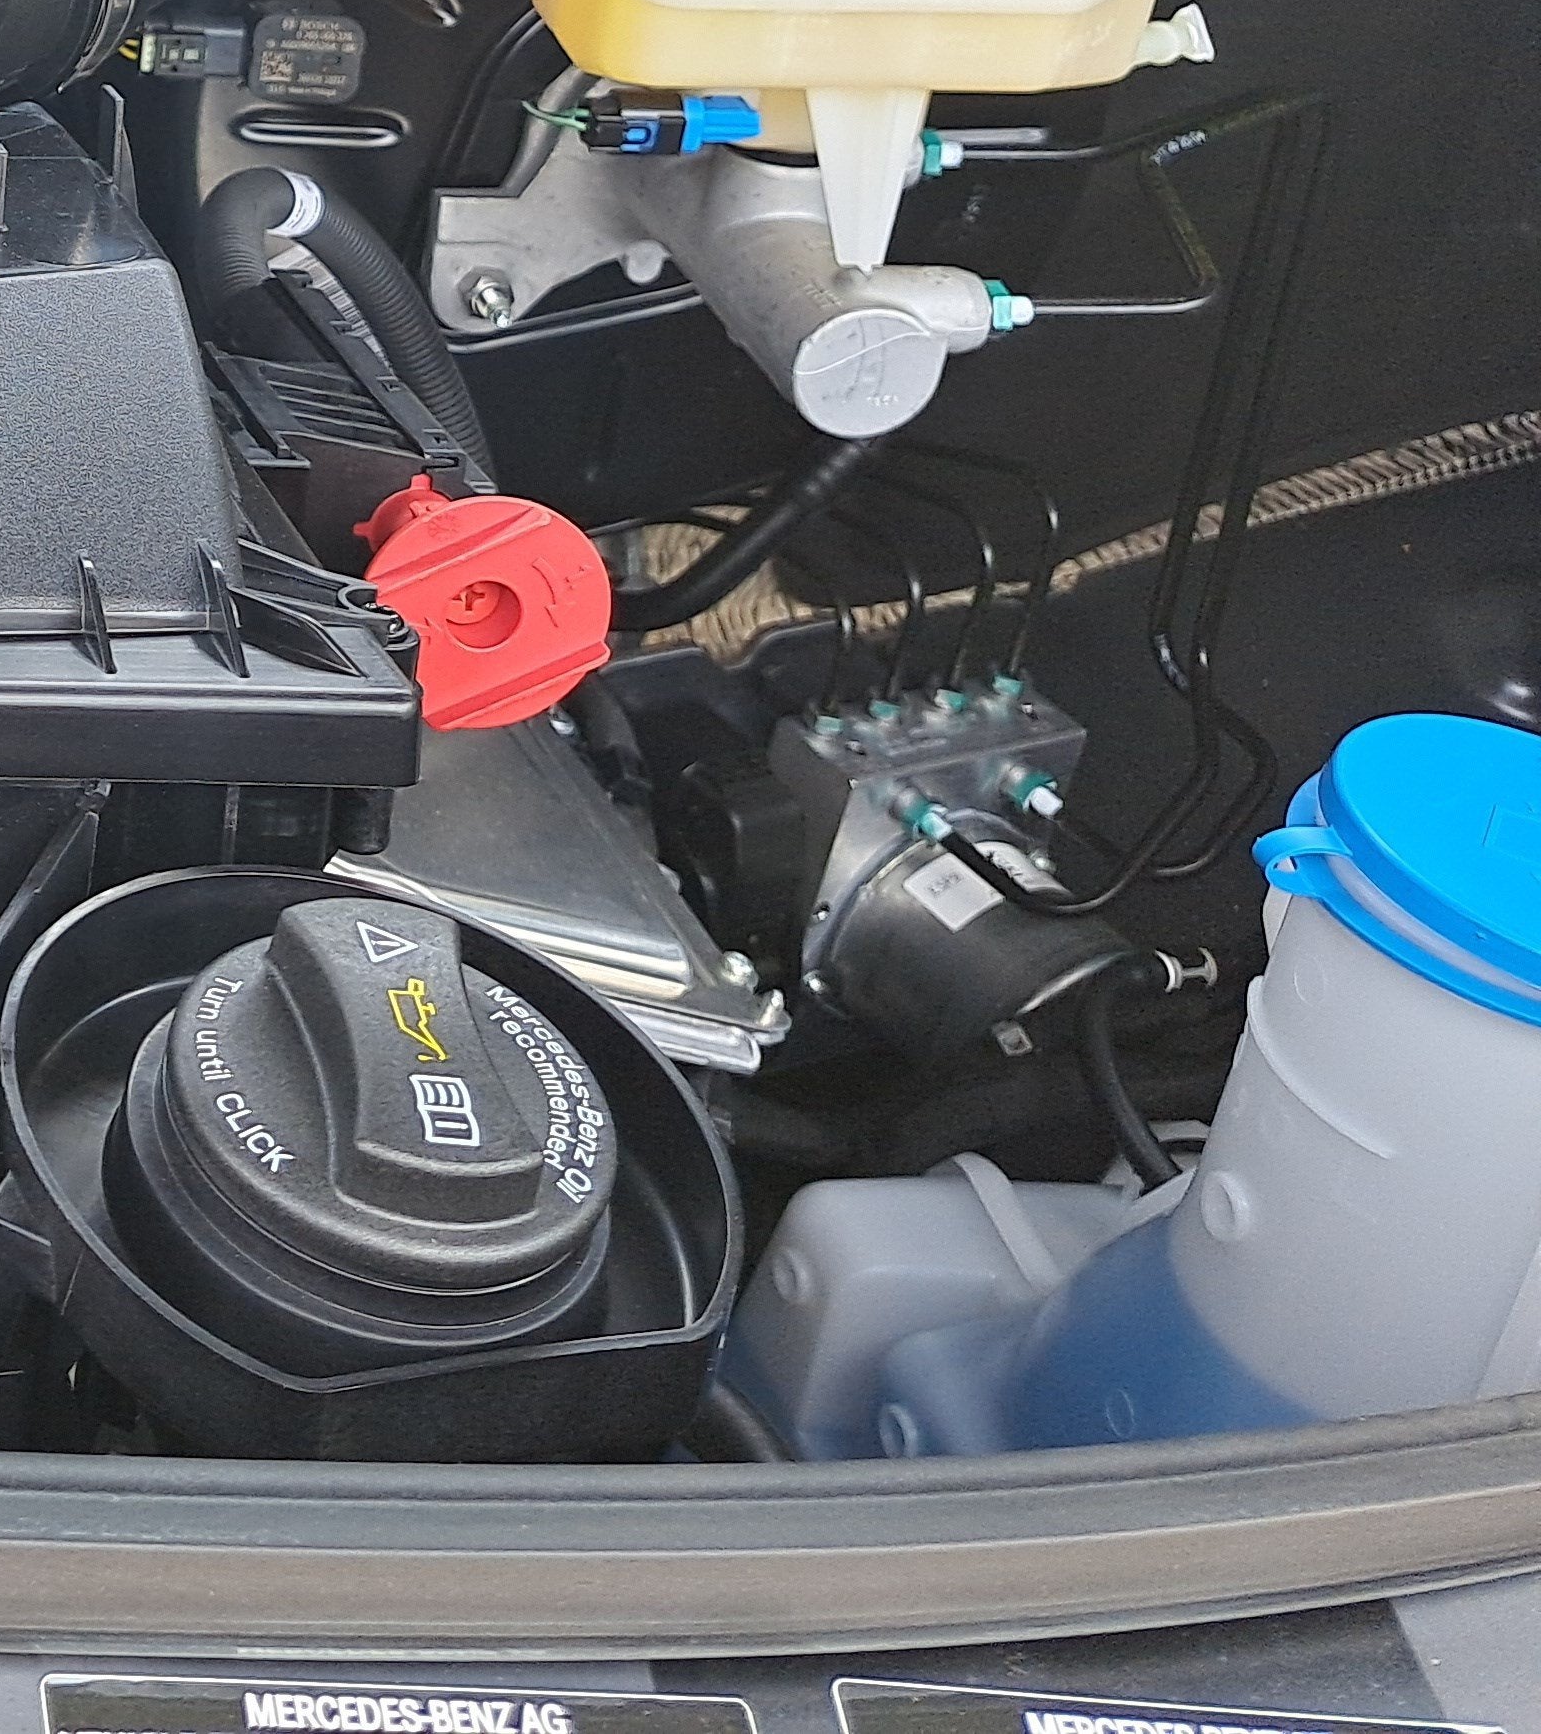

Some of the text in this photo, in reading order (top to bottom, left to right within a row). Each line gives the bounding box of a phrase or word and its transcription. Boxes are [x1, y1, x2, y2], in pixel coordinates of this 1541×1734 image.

[196, 976, 296, 1173] Turn until CLICK
[485, 985, 604, 1204] Mercedes-Benz Oil
[489, 1010, 577, 1171] recommended
[245, 1692, 570, 1734] MERCEDES-BENZ AG
